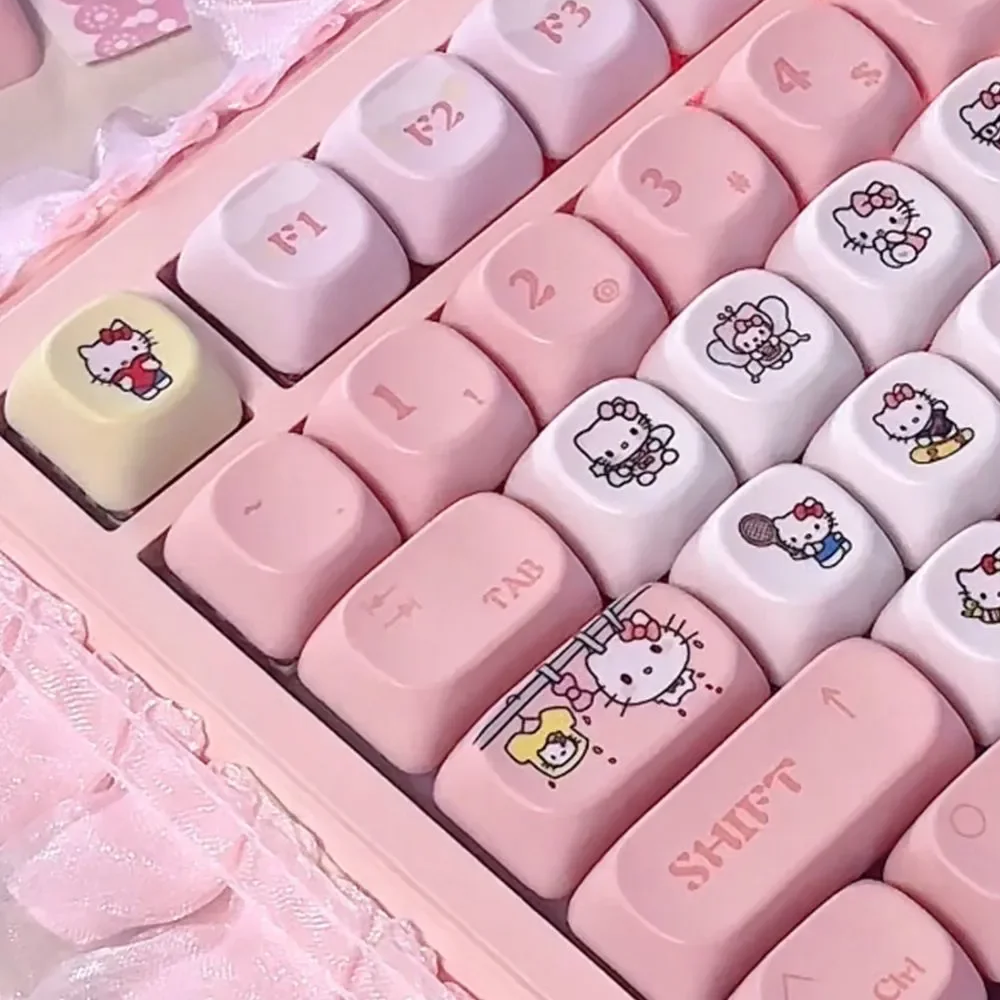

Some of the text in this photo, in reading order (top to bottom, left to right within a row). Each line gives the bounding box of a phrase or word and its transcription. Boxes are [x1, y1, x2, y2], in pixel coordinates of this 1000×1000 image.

[534, 0, 591, 44] F3
[773, 56, 882, 94] 4 $
[403, 101, 464, 147] F2
[640, 167, 682, 207] 3
[268, 211, 327, 255] F1
[509, 267, 555, 310] 2
[372, 384, 418, 421] 1
[482, 558, 545, 610] TAB
[668, 757, 802, 891] SHIFT
[873, 956, 927, 1000] Ctrl
